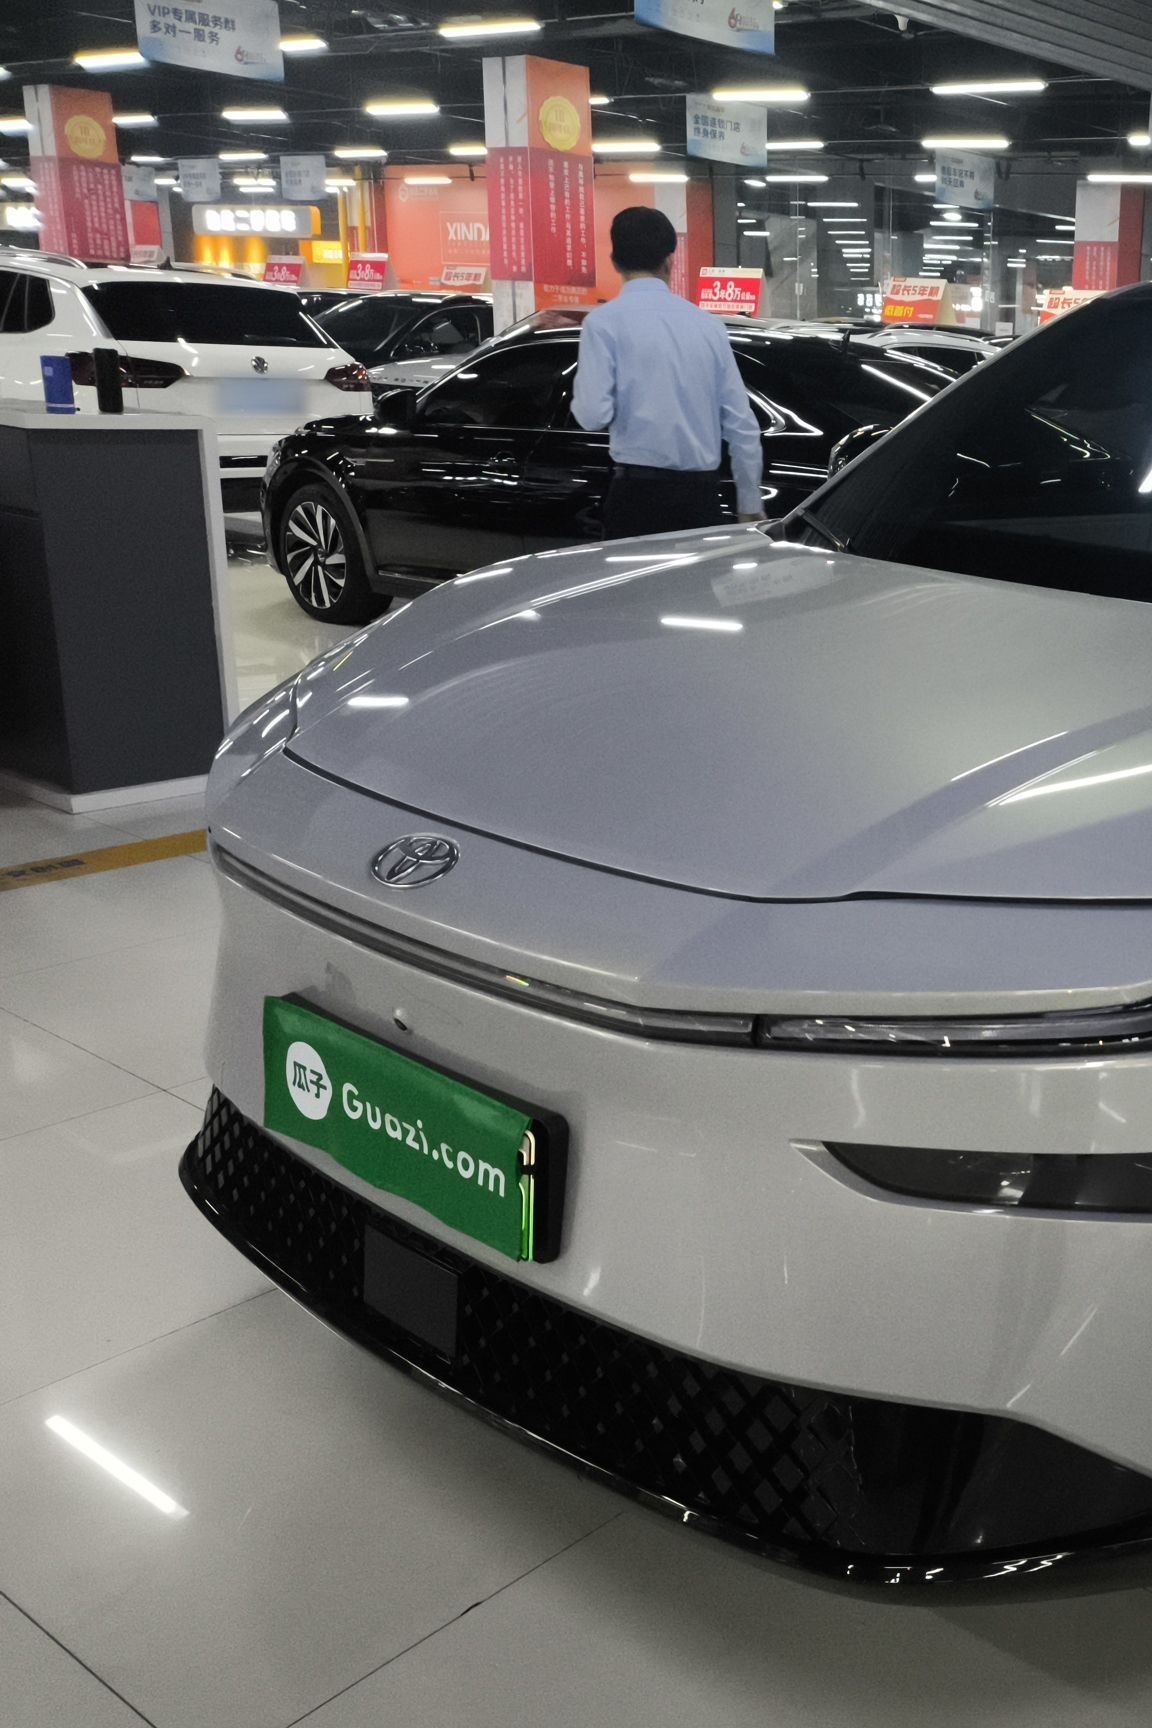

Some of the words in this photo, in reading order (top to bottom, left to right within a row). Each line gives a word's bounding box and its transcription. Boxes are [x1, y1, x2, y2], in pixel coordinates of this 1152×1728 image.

[147, 3, 237, 32] VIP专属服务群
[150, 20, 221, 46] 多对一服务
[292, 1060, 328, 1099] 瓜子
[342, 1082, 506, 1198] Guazi.com
